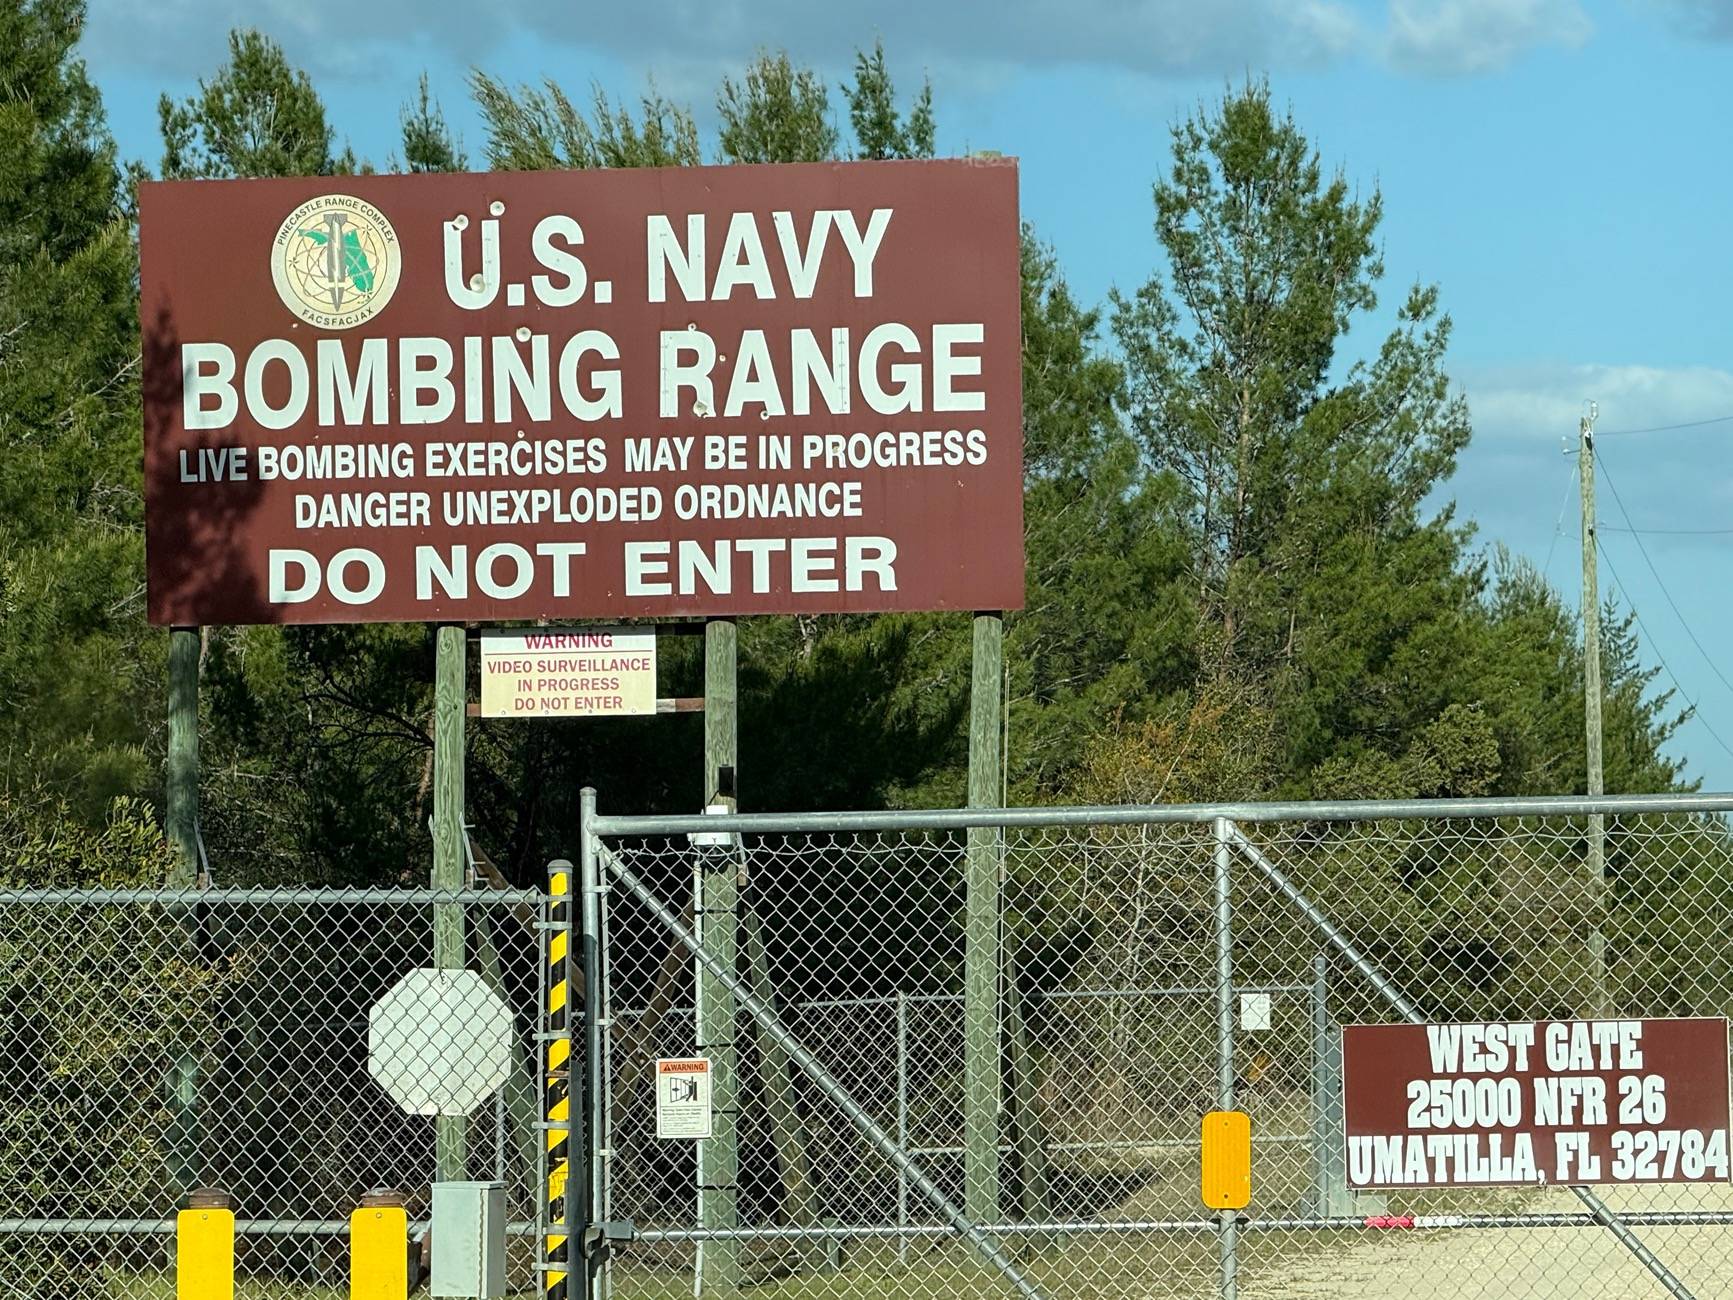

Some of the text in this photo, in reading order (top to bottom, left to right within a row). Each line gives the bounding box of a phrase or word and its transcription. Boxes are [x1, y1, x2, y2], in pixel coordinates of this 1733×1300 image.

[277, 198, 395, 246] PINECASTLE RANGE COMPLEX
[443, 208, 894, 310] U.S. NAVY
[302, 306, 375, 327] FACSFACJAX
[181, 322, 987, 431] BOMBING RANGE
[179, 429, 989, 484] LIVE BOMBING EXERCISES MAY BE IN PROGRESS
[295, 481, 864, 529] DANGER UNEXPLODED ORDNANCE
[268, 535, 898, 605] DO NOT ENTER
[524, 632, 613, 650] WARNING
[487, 658, 651, 674] VIDEO SURVEILLANCE
[517, 677, 620, 692] IN PROGRESS
[514, 695, 623, 711] DO NOT ENTER
[671, 1063, 705, 1072] WARNING
[1426, 1020, 1644, 1074] WEST GATE
[1406, 1074, 1667, 1129] 25000 NFR 26
[1348, 1128, 1729, 1185] UMATILLA, FL 32784
